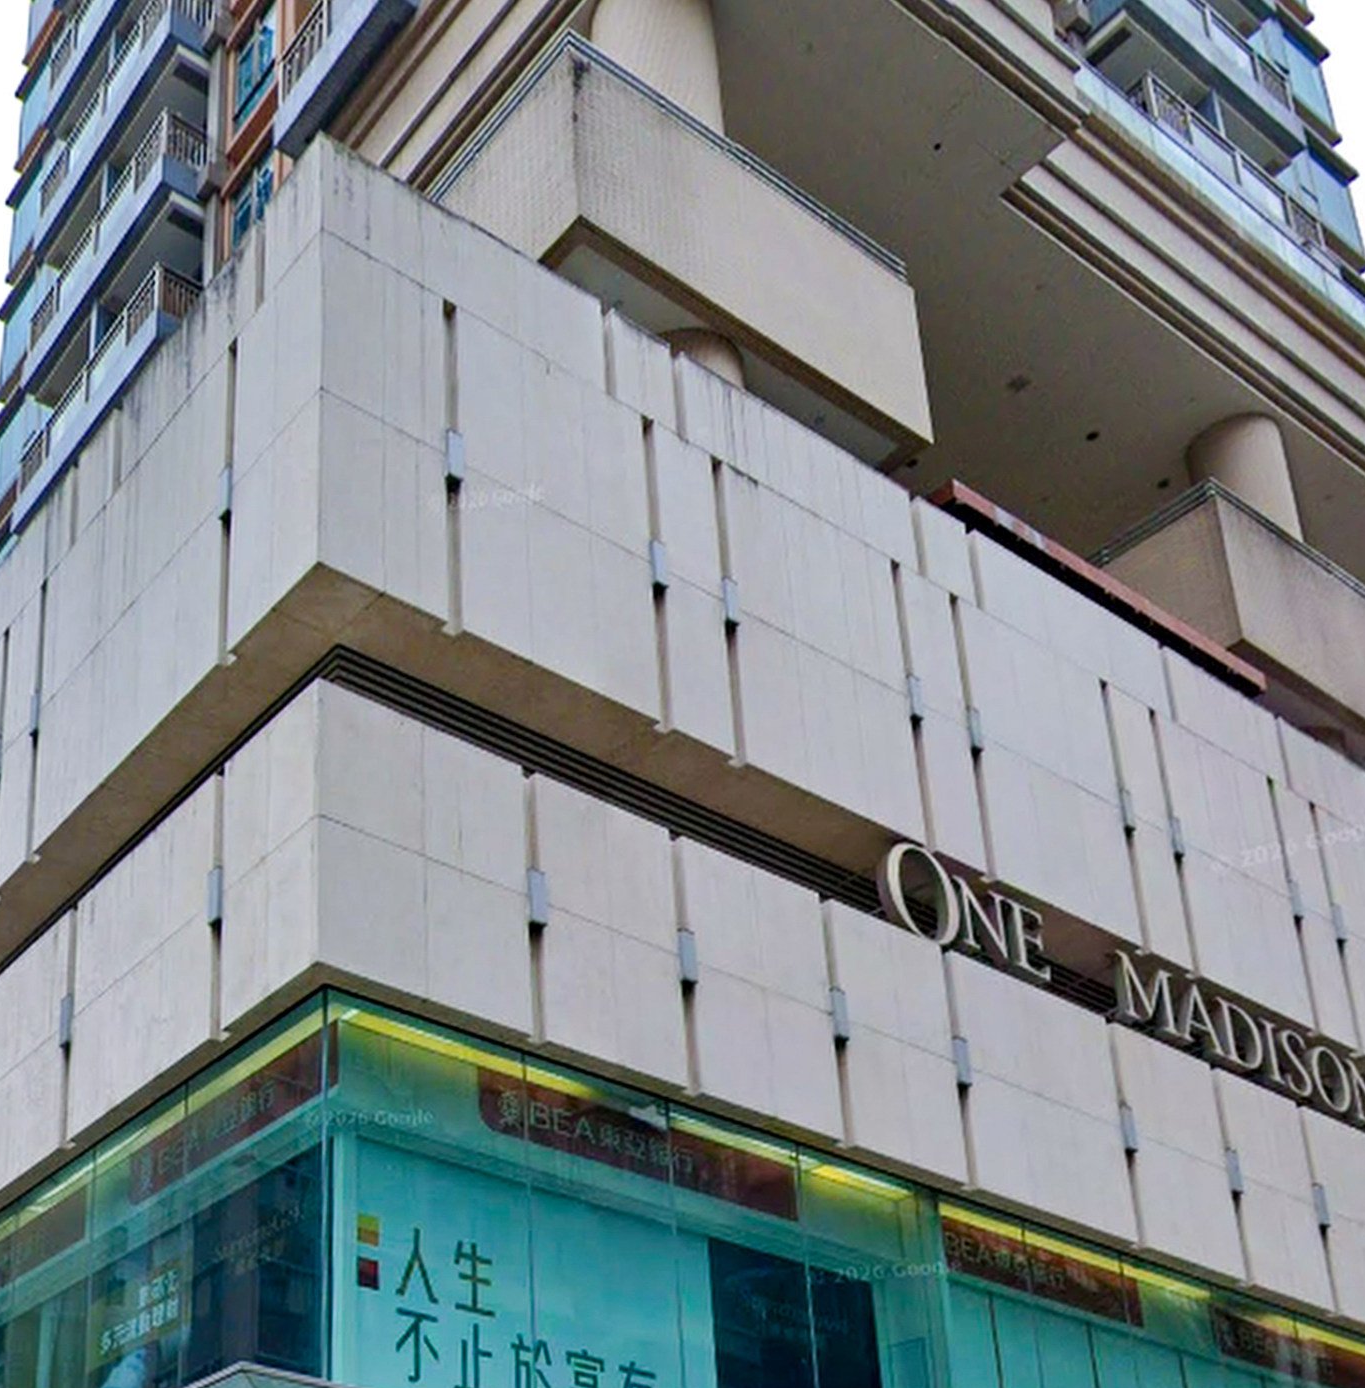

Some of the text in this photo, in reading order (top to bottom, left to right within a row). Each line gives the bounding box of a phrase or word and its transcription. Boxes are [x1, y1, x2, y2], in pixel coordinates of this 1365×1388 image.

[877, 841, 1052, 982] ONE
[527, 1101, 596, 1146] BEA
[395, 1228, 495, 1317] 人生
